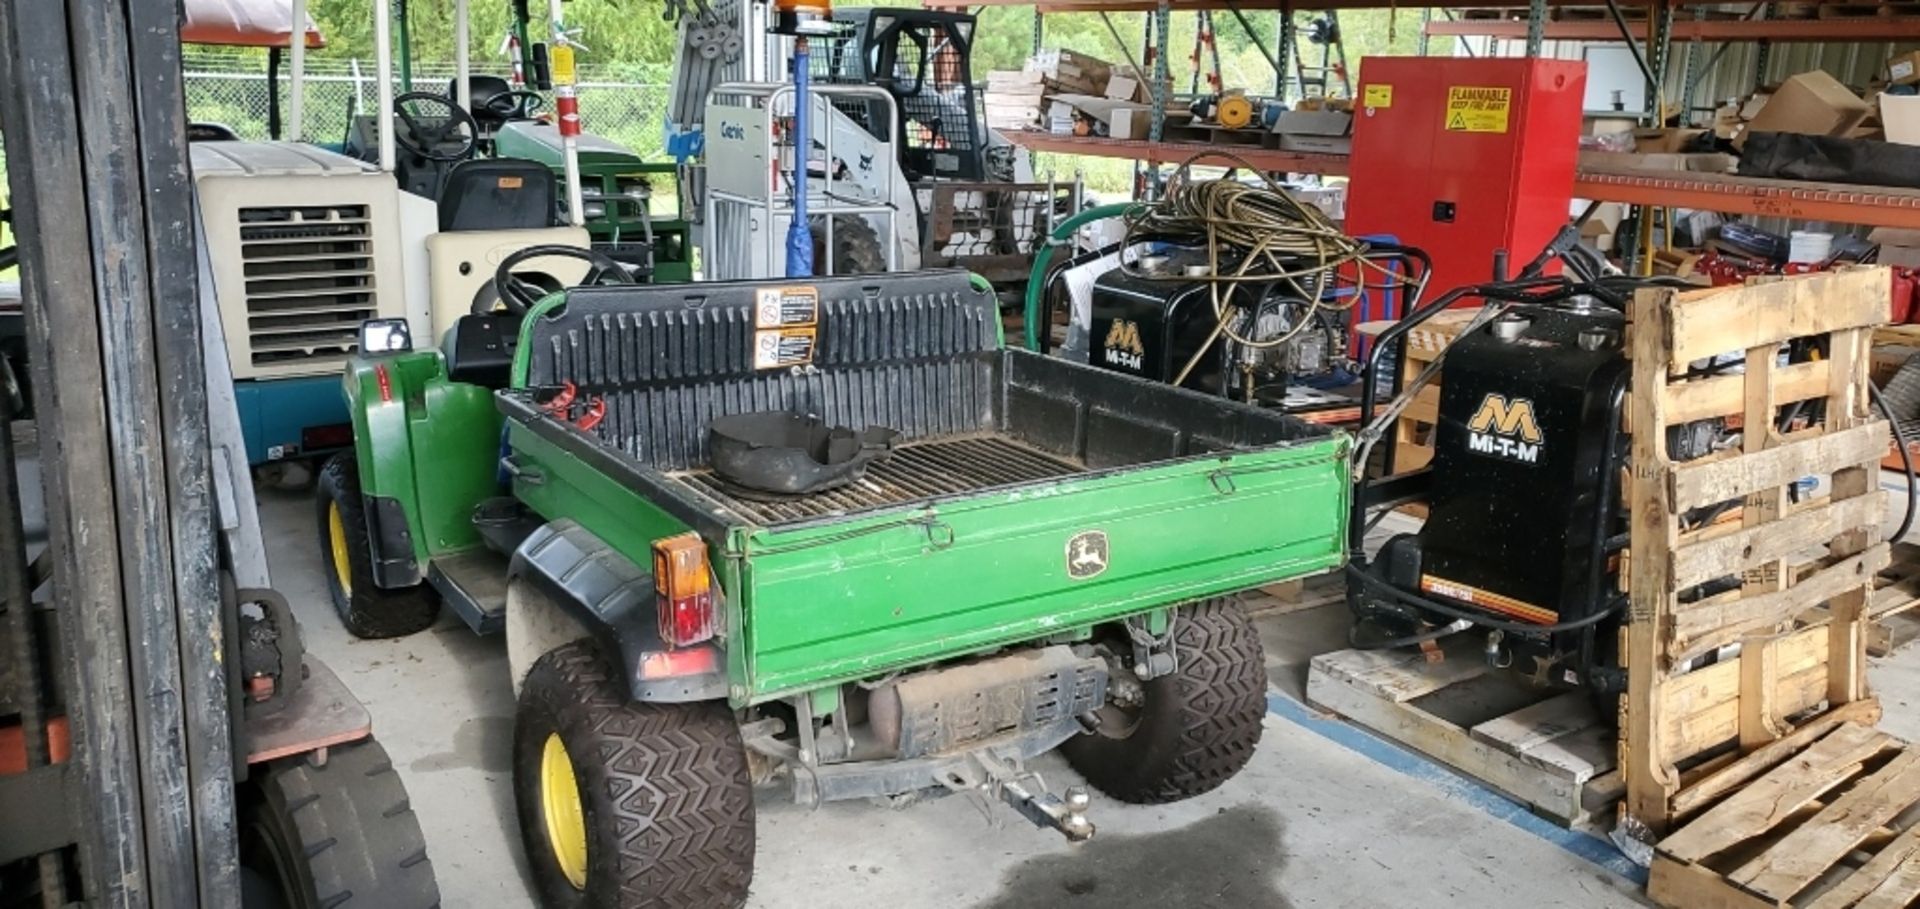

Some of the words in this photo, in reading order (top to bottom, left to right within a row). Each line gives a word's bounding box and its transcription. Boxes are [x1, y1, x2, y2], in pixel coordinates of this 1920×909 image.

[1451, 88, 1508, 101] FLAMMABLE
[721, 120, 744, 141] Genie
[1469, 433, 1538, 463] Mi-T-M
